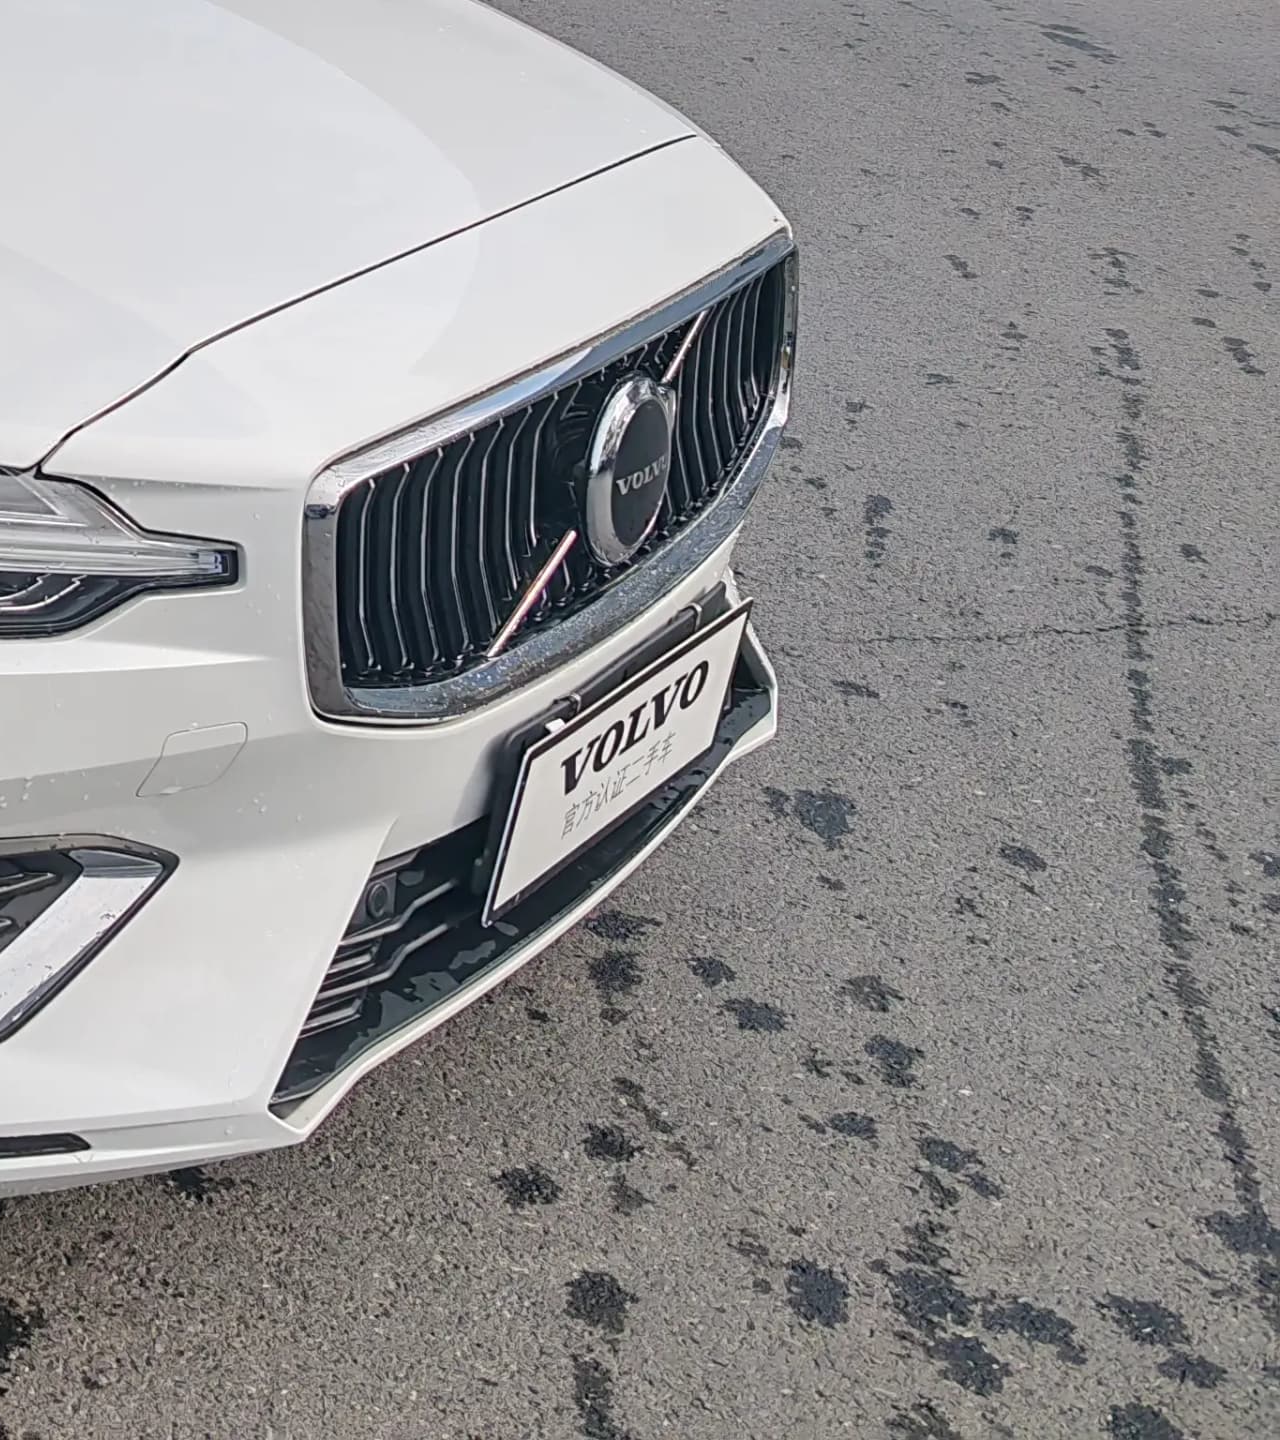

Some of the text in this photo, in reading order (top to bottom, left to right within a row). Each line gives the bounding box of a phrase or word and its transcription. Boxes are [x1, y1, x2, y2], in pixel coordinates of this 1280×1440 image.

[561, 660, 709, 795] VOLVO
[561, 733, 676, 839] 官方认证二手车
